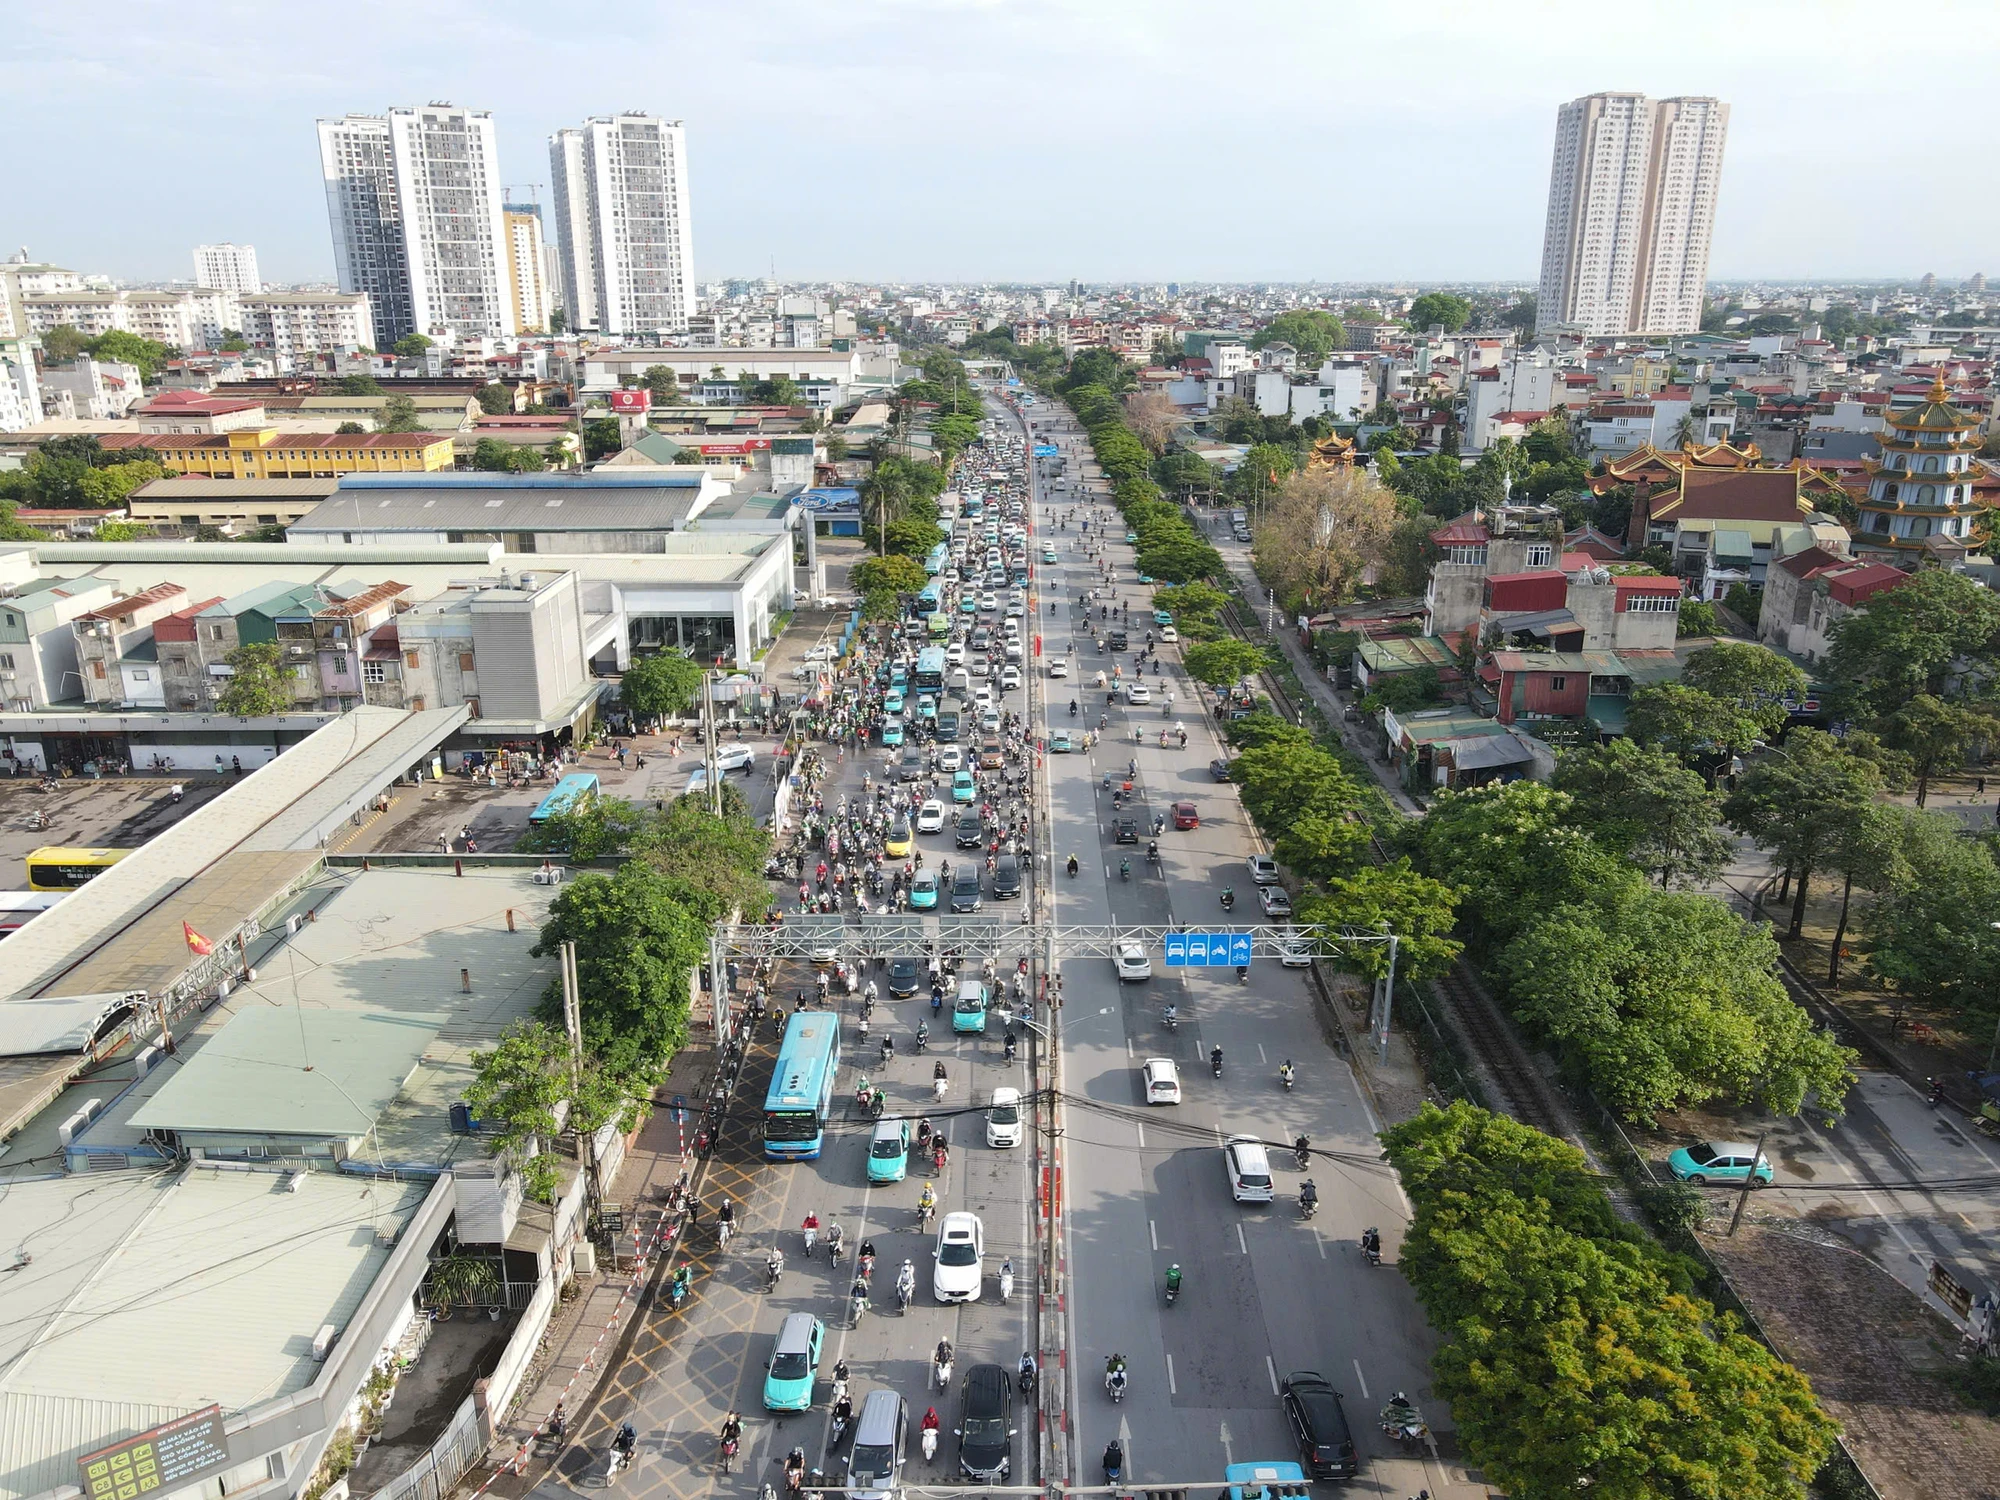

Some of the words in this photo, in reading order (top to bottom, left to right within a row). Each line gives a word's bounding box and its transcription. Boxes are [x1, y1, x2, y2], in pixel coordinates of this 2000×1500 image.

[797, 496, 821, 506] Ford
[167, 1433, 183, 1443] MÁY
[184, 1427, 199, 1436] VÀO
[200, 1421, 213, 1430] BẾN
[158, 1444, 174, 1453] QUA
[176, 1445, 191, 1454] VÀO
[192, 1440, 205, 1448] BẾN
[207, 1449, 222, 1458] VÀO
[162, 1458, 177, 1467] QUA
[91, 1464, 106, 1475] C10
[165, 1473, 178, 1482] BẾN
[179, 1467, 194, 1476] QUA
[195, 1458, 216, 1469] CỔNG
[95, 1481, 109, 1491] C8
